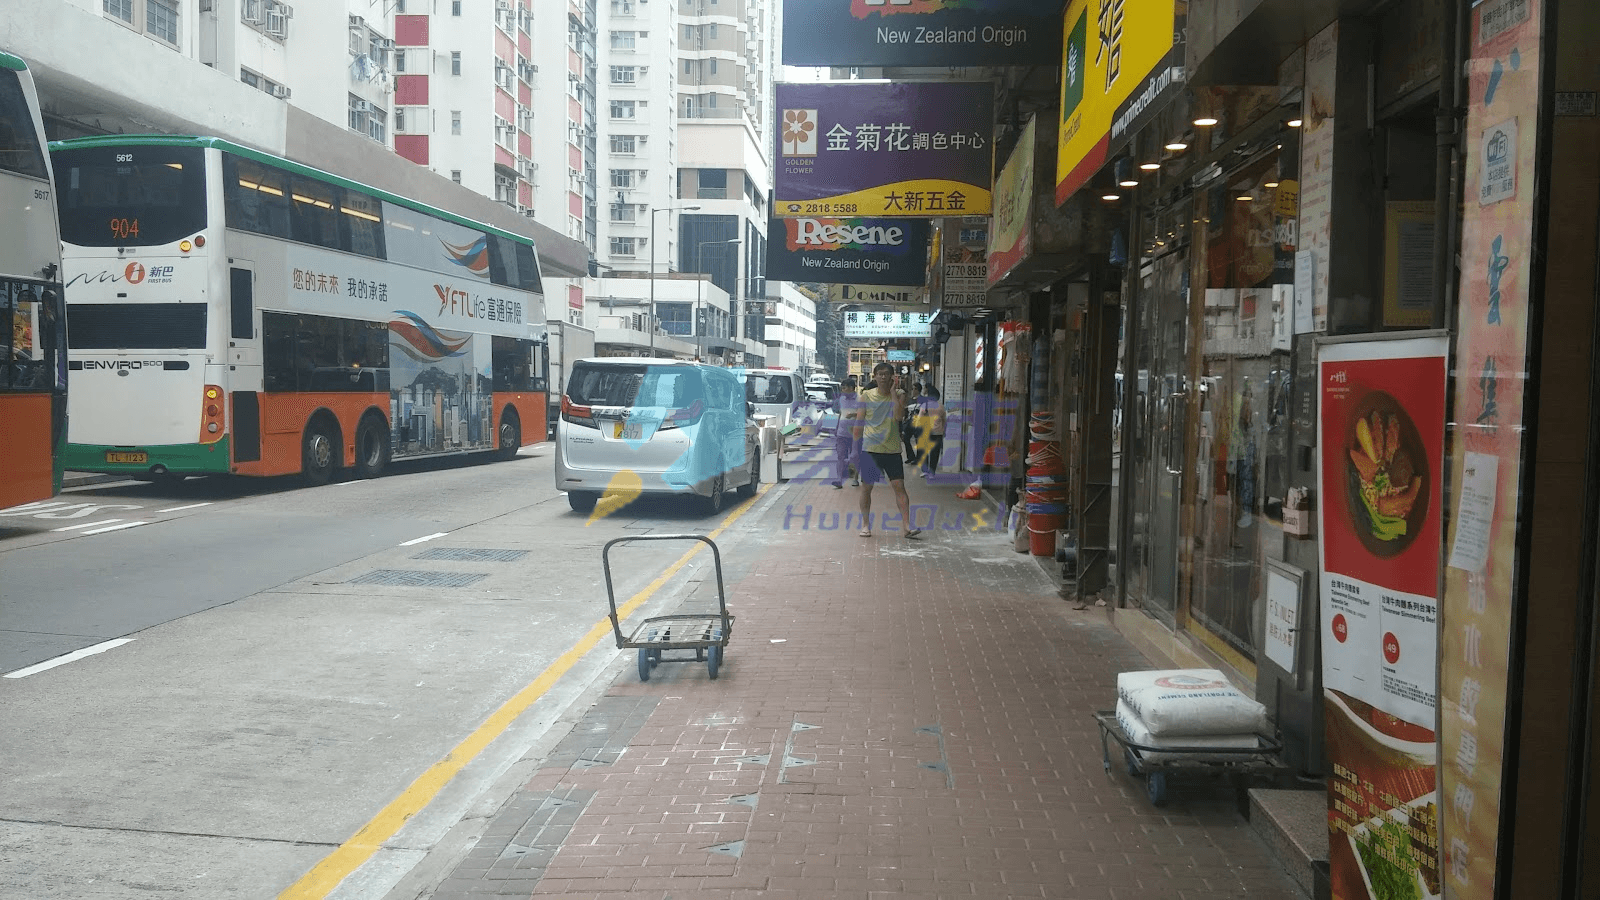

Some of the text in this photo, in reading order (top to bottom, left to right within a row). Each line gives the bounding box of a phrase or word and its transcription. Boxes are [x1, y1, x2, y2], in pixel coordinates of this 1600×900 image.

[876, 25, 1027, 46] New Zealand Origin
[1111, 66, 1171, 140] www.primecredit.com
[116, 153, 133, 162] 5612
[34, 189, 50, 201] 5617
[883, 190, 967, 212] 大新五金
[805, 204, 858, 213] 2818 5588
[110, 218, 139, 238] 904
[795, 218, 904, 246] Resene
[149, 265, 174, 277] 新巴
[802, 256, 890, 273] New Zealand Origin
[945, 265, 987, 276] 2770 8819
[292, 267, 388, 303] 您的未來 我的承諾
[944, 294, 965, 304] 2770
[487, 297, 522, 325] 富通保險
[110, 453, 144, 462] TL 1123
